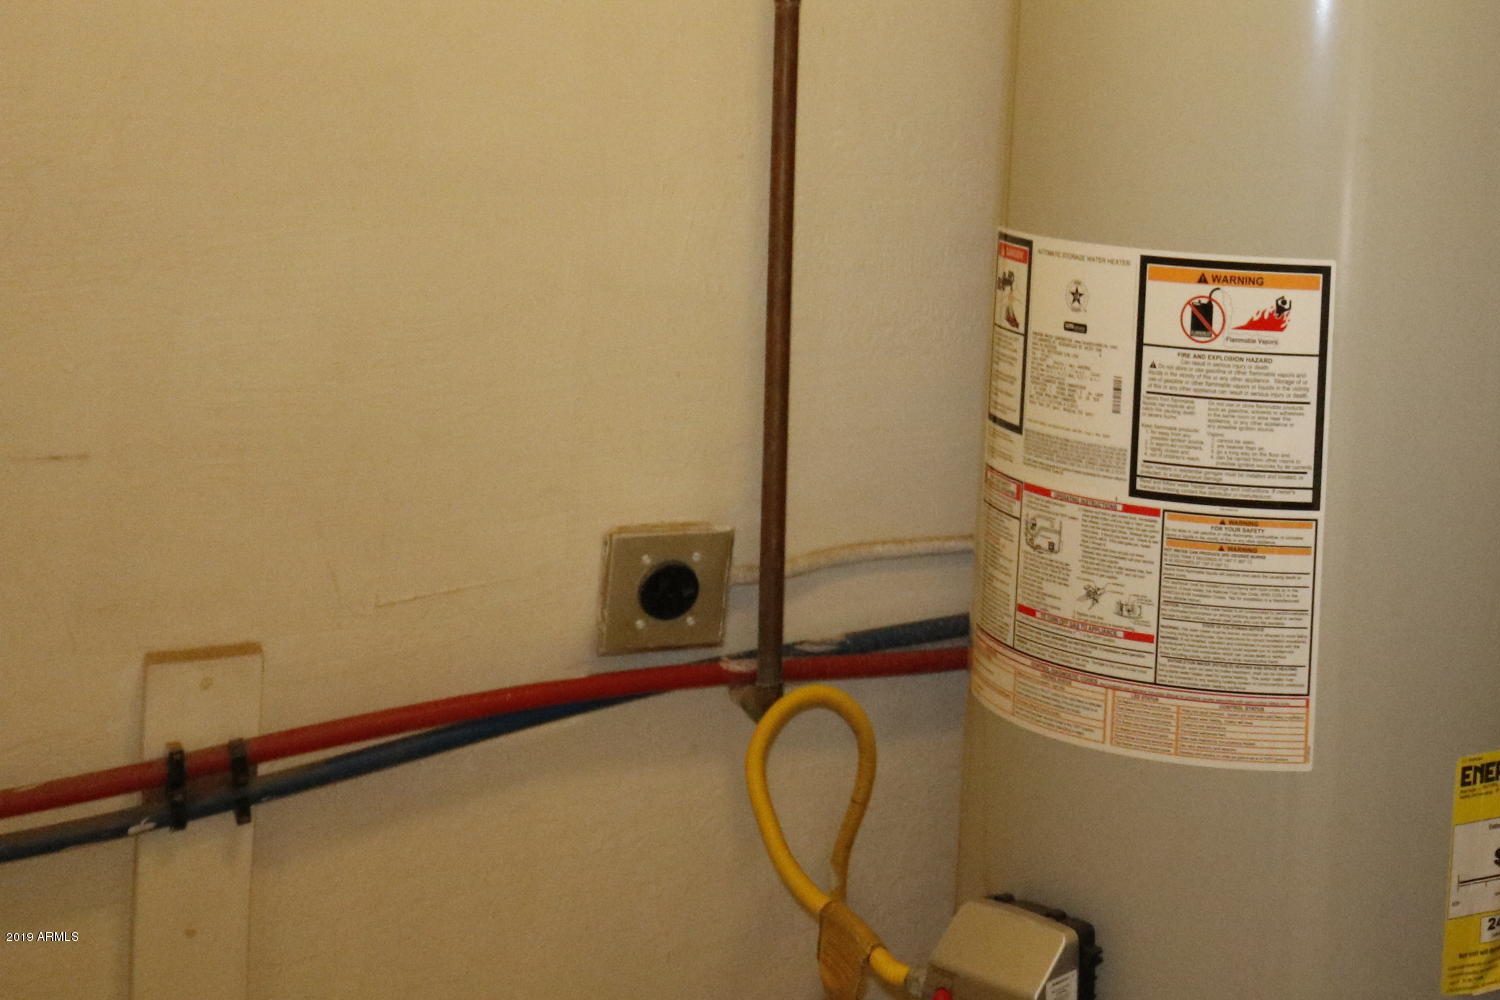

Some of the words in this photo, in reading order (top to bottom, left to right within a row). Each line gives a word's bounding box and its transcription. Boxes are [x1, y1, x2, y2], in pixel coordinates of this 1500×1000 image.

[1211, 274, 1265, 286] WARNING
[1207, 354, 1245, 362] EXPLOSION
[1228, 519, 1259, 527] WARNING
